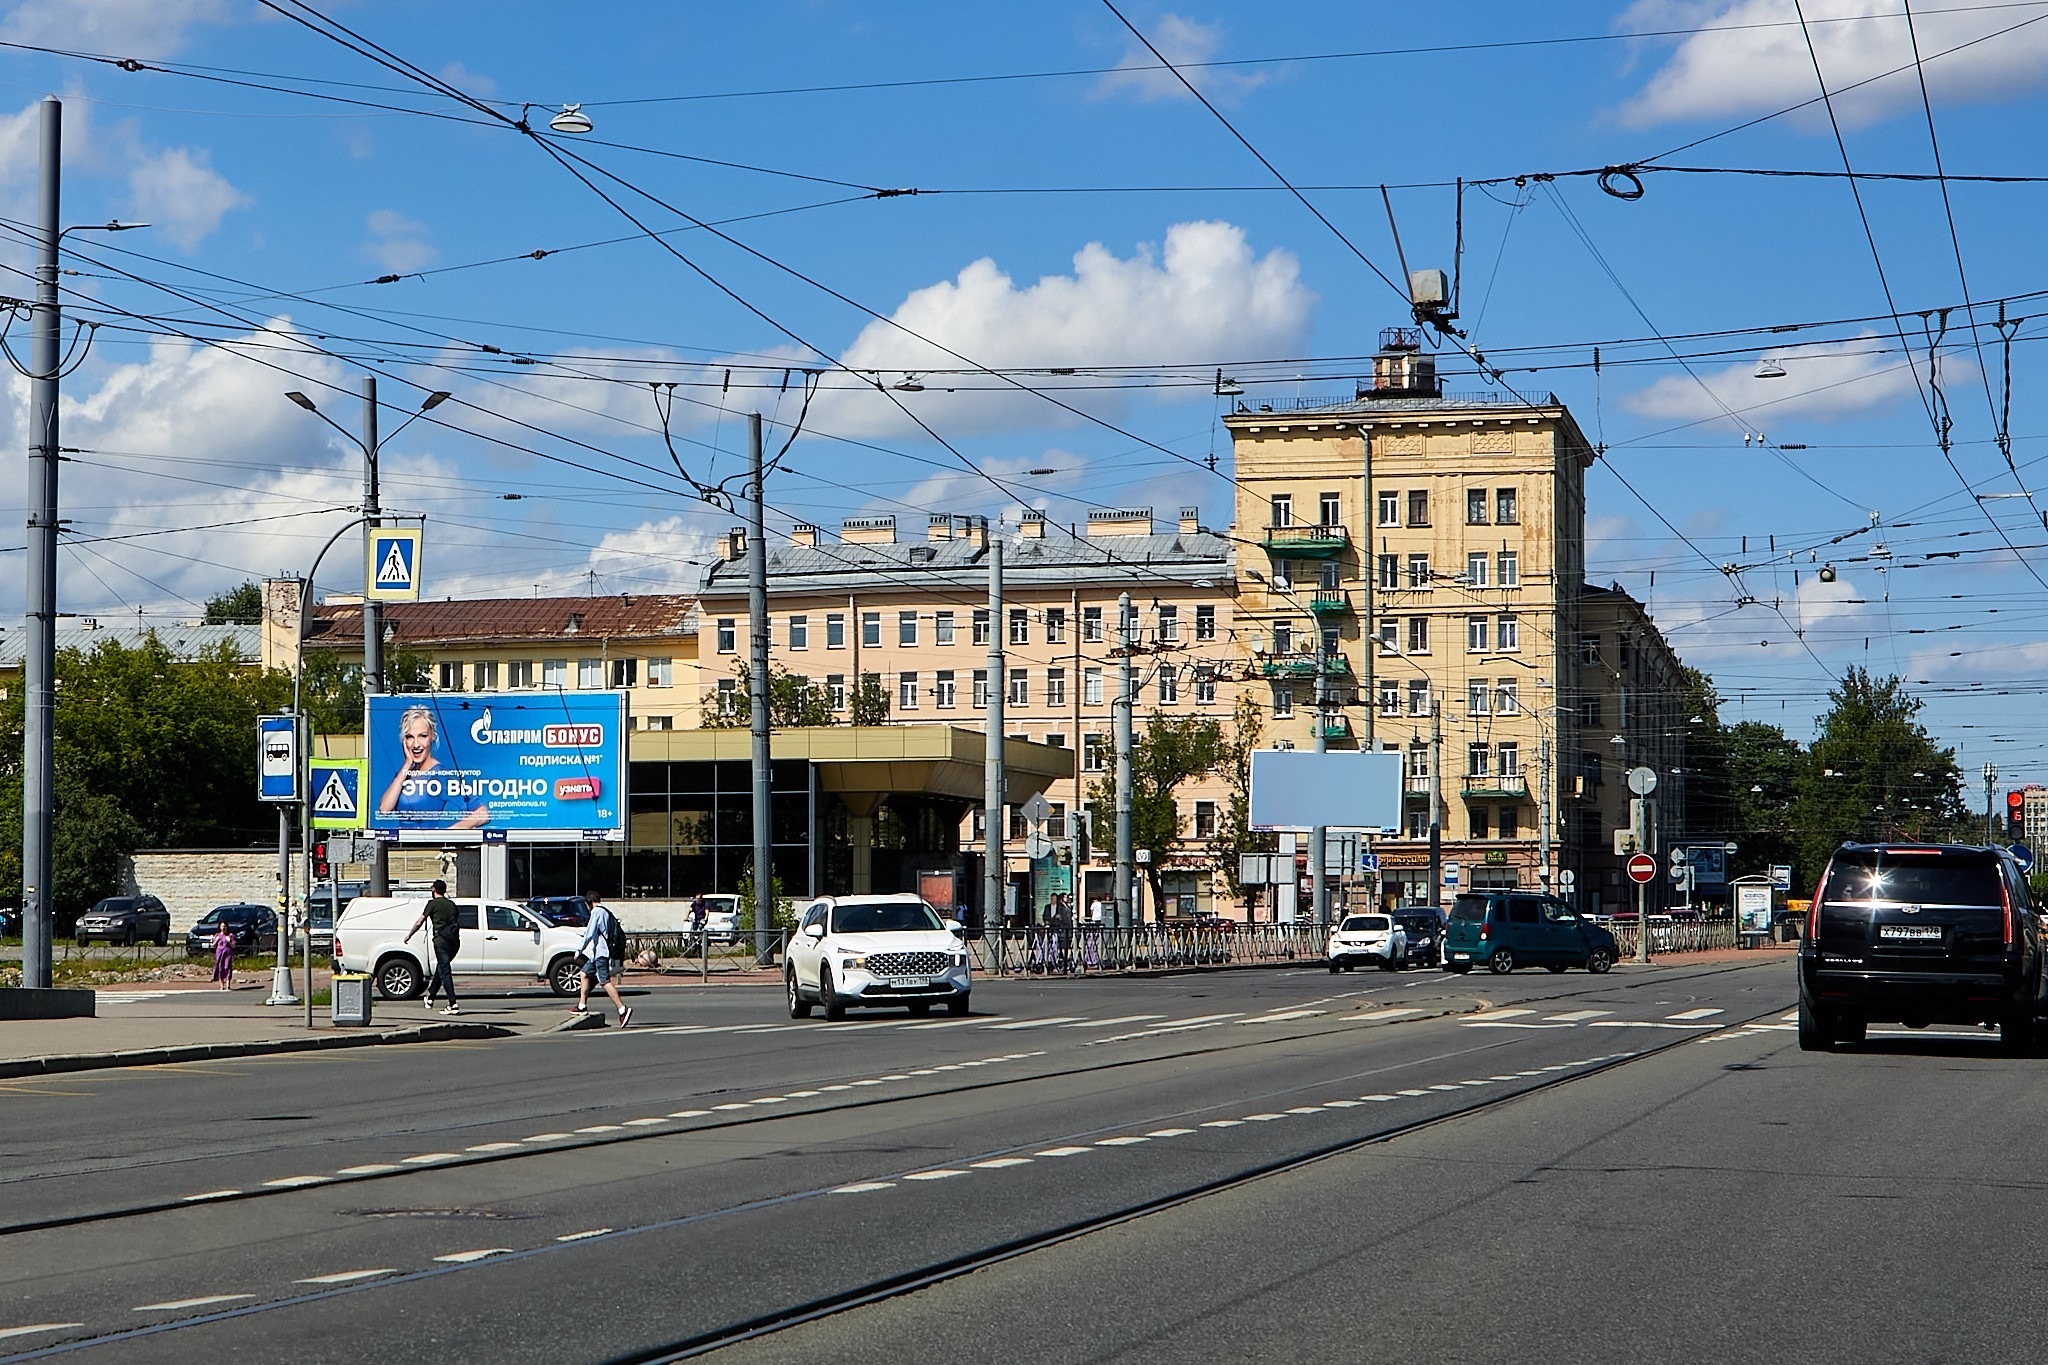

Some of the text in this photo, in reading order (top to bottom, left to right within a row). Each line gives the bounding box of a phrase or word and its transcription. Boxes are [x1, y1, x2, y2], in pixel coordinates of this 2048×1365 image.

[490, 727, 600, 745] ГАЗПРОМ БОНУС
[519, 755, 581, 767] ПОДПИСКА
[402, 778, 548, 800] ЭТО ВЫГОДНО
[559, 784, 593, 796] узнать
[488, 800, 547, 809] gazprombonus.ru
[597, 809, 613, 819] 18+
[319, 863, 328, 875] 6
